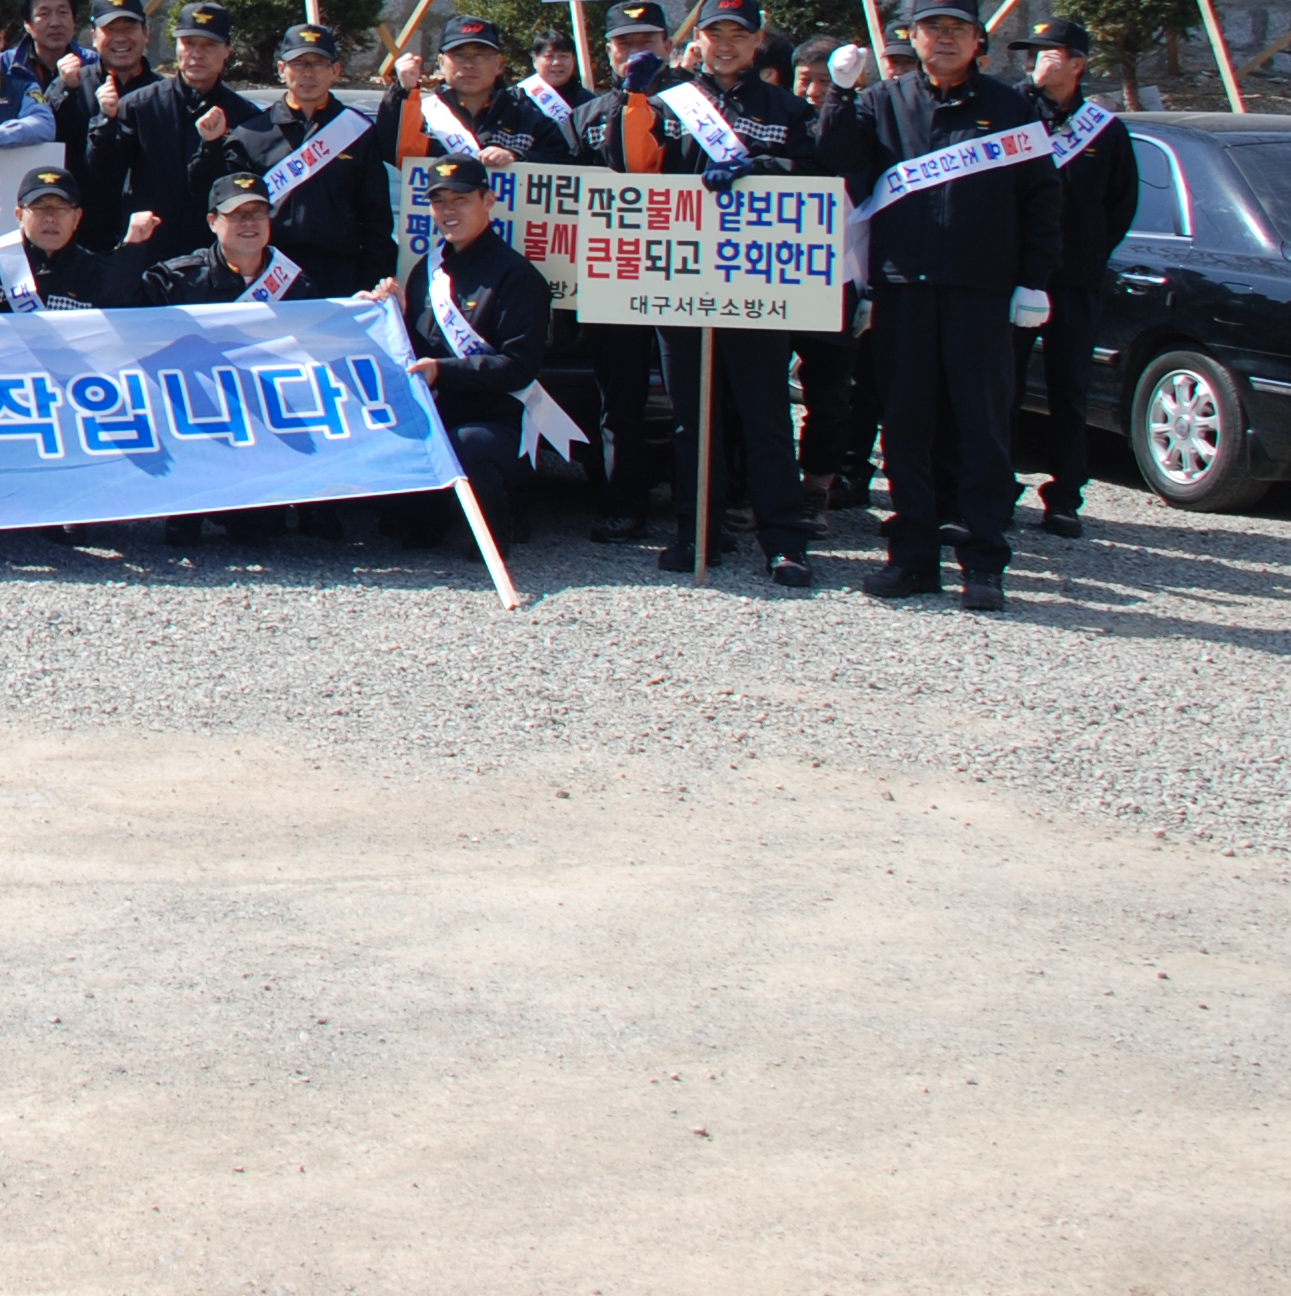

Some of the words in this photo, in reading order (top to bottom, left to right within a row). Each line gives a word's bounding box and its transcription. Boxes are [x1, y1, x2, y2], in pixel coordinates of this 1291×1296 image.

[887, 145, 980, 194] 조심합시다
[526, 174, 580, 215] 버린
[716, 189, 837, 234] 얕보다가
[524, 221, 577, 264] 불씨
[714, 239, 837, 286] 후회한다
[630, 295, 787, 319] 대구서부소방서
